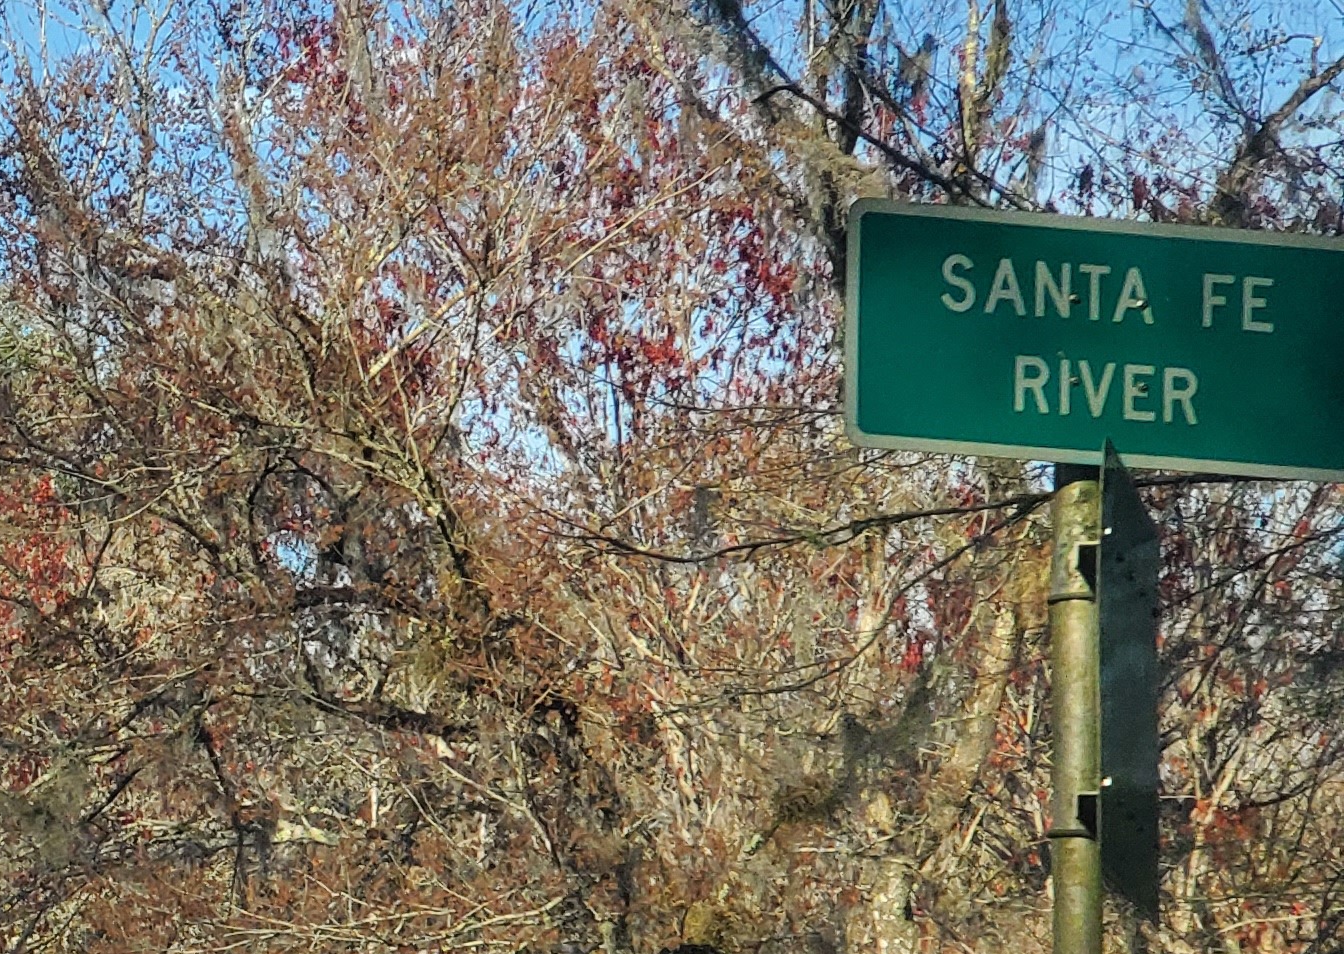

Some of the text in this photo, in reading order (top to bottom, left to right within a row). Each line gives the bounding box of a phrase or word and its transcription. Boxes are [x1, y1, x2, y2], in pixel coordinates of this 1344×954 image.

[940, 253, 1275, 333] SANTA FE
[1013, 354, 1199, 425] RIVER
